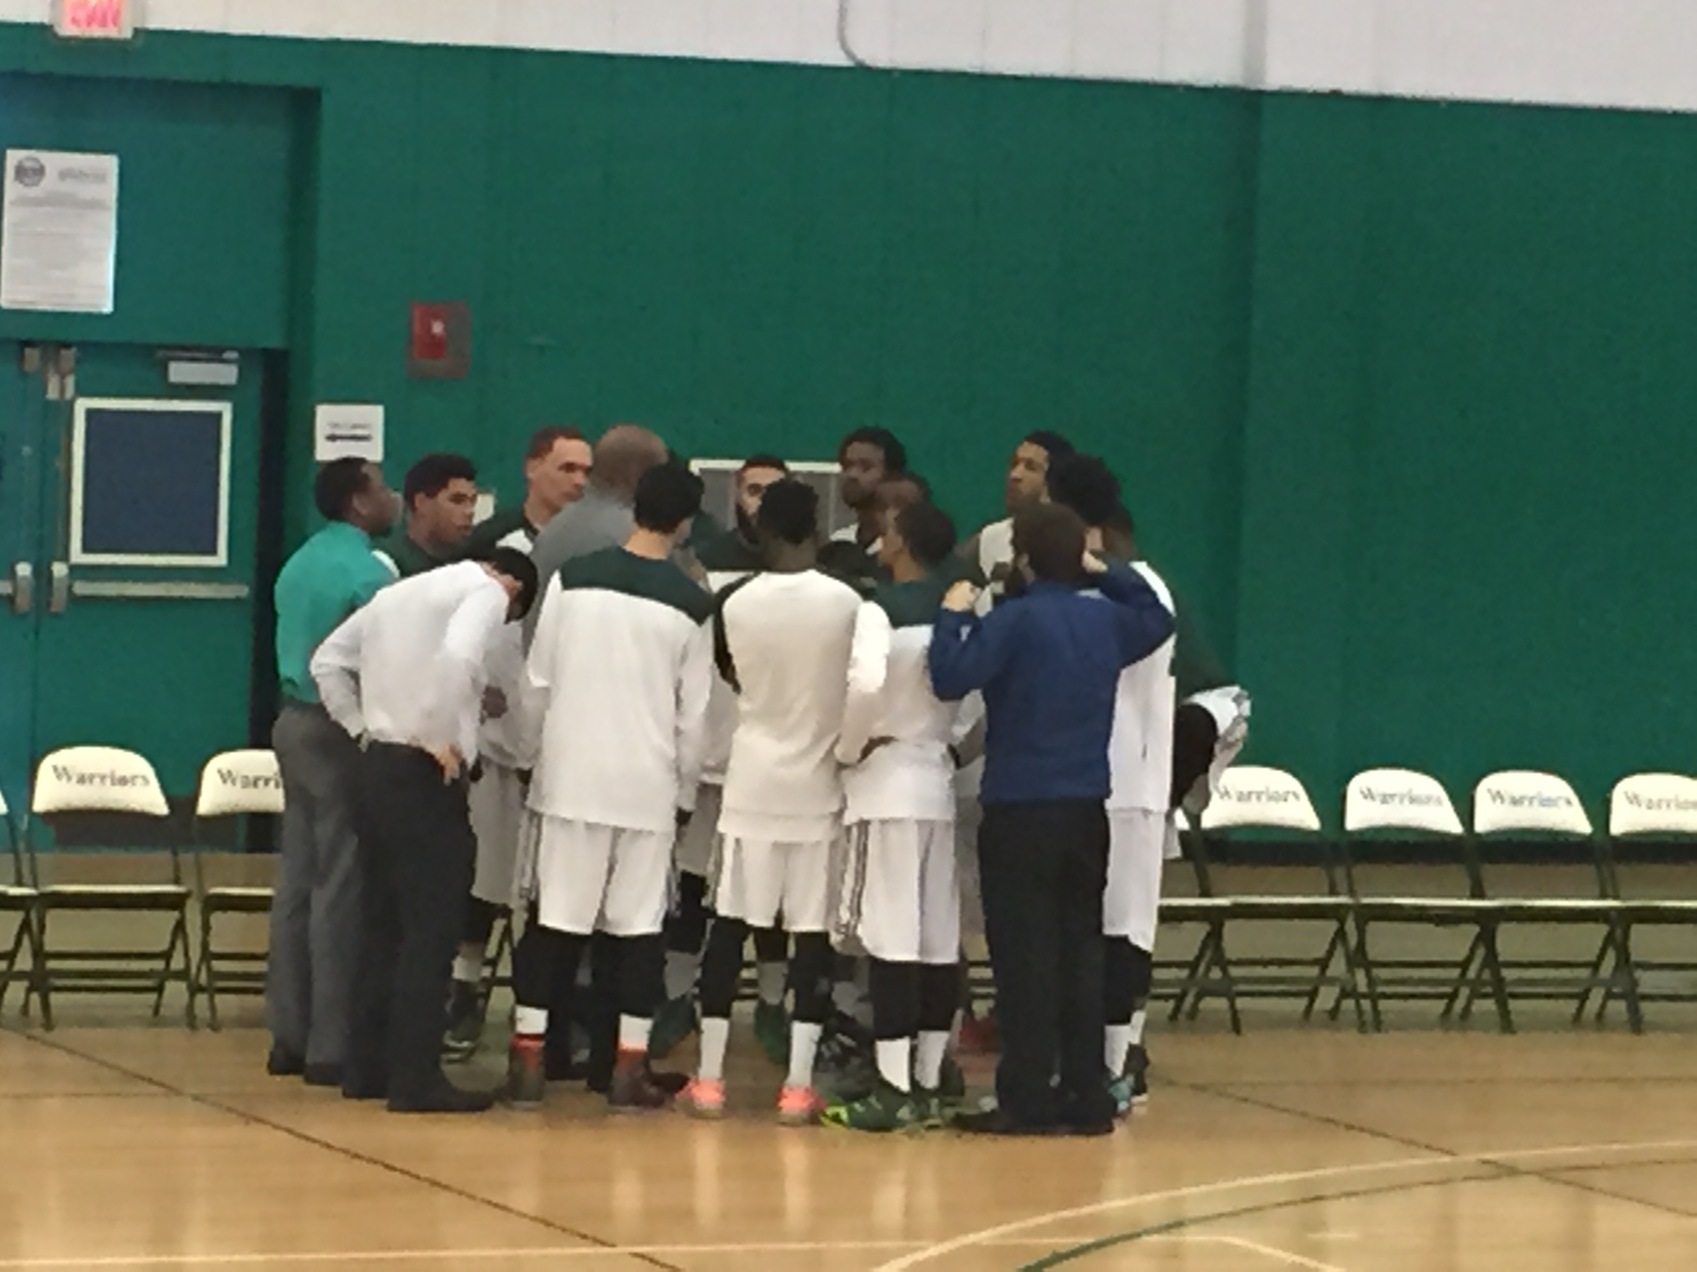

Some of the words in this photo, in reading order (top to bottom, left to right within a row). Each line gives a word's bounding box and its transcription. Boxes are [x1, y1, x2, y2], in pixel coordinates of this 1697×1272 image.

[52, 764, 150, 787] Warriors
[1359, 785, 1444, 806] Warriors
[1487, 788, 1574, 808] Warriors
